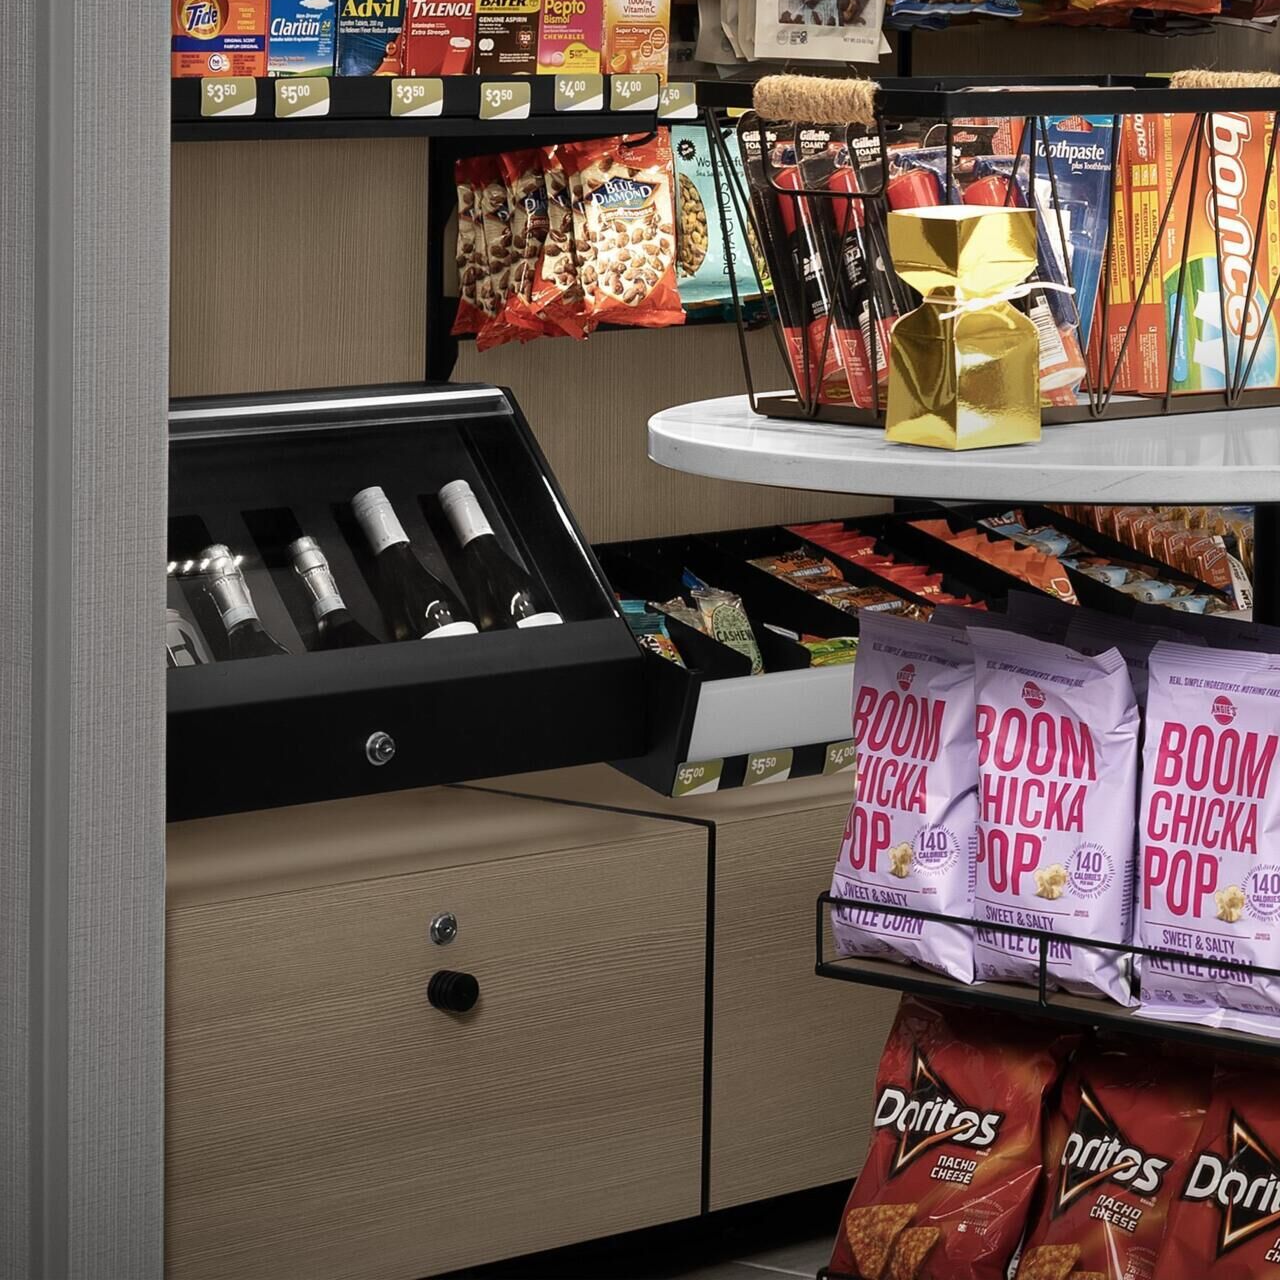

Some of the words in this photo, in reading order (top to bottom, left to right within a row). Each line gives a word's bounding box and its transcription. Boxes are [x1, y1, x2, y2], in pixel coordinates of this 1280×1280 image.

[412, 0, 473, 17] TYLENOL
[271, 17, 320, 37] Claritin
[544, 14, 569, 24] Bismol
[1035, 141, 1104, 160] Toothpaste
[592, 186, 652, 206] DIAMOND
[606, 180, 634, 193] BLUE
[1154, 722, 1278, 800] BOOM
[1148, 790, 1257, 855] CHICKA
[1143, 847, 1217, 918] POP
[1251, 873, 1280, 895] 140
[1252, 892, 1280, 904] CALORIES
[1162, 930, 1192, 949] SWEET
[1194, 935, 1203, 949] &
[1206, 935, 1235, 955] SALTY
[874, 1088, 1000, 1147] Doritos
[938, 1155, 978, 1172] NACHO
[931, 1167, 973, 1185] CHEESE
